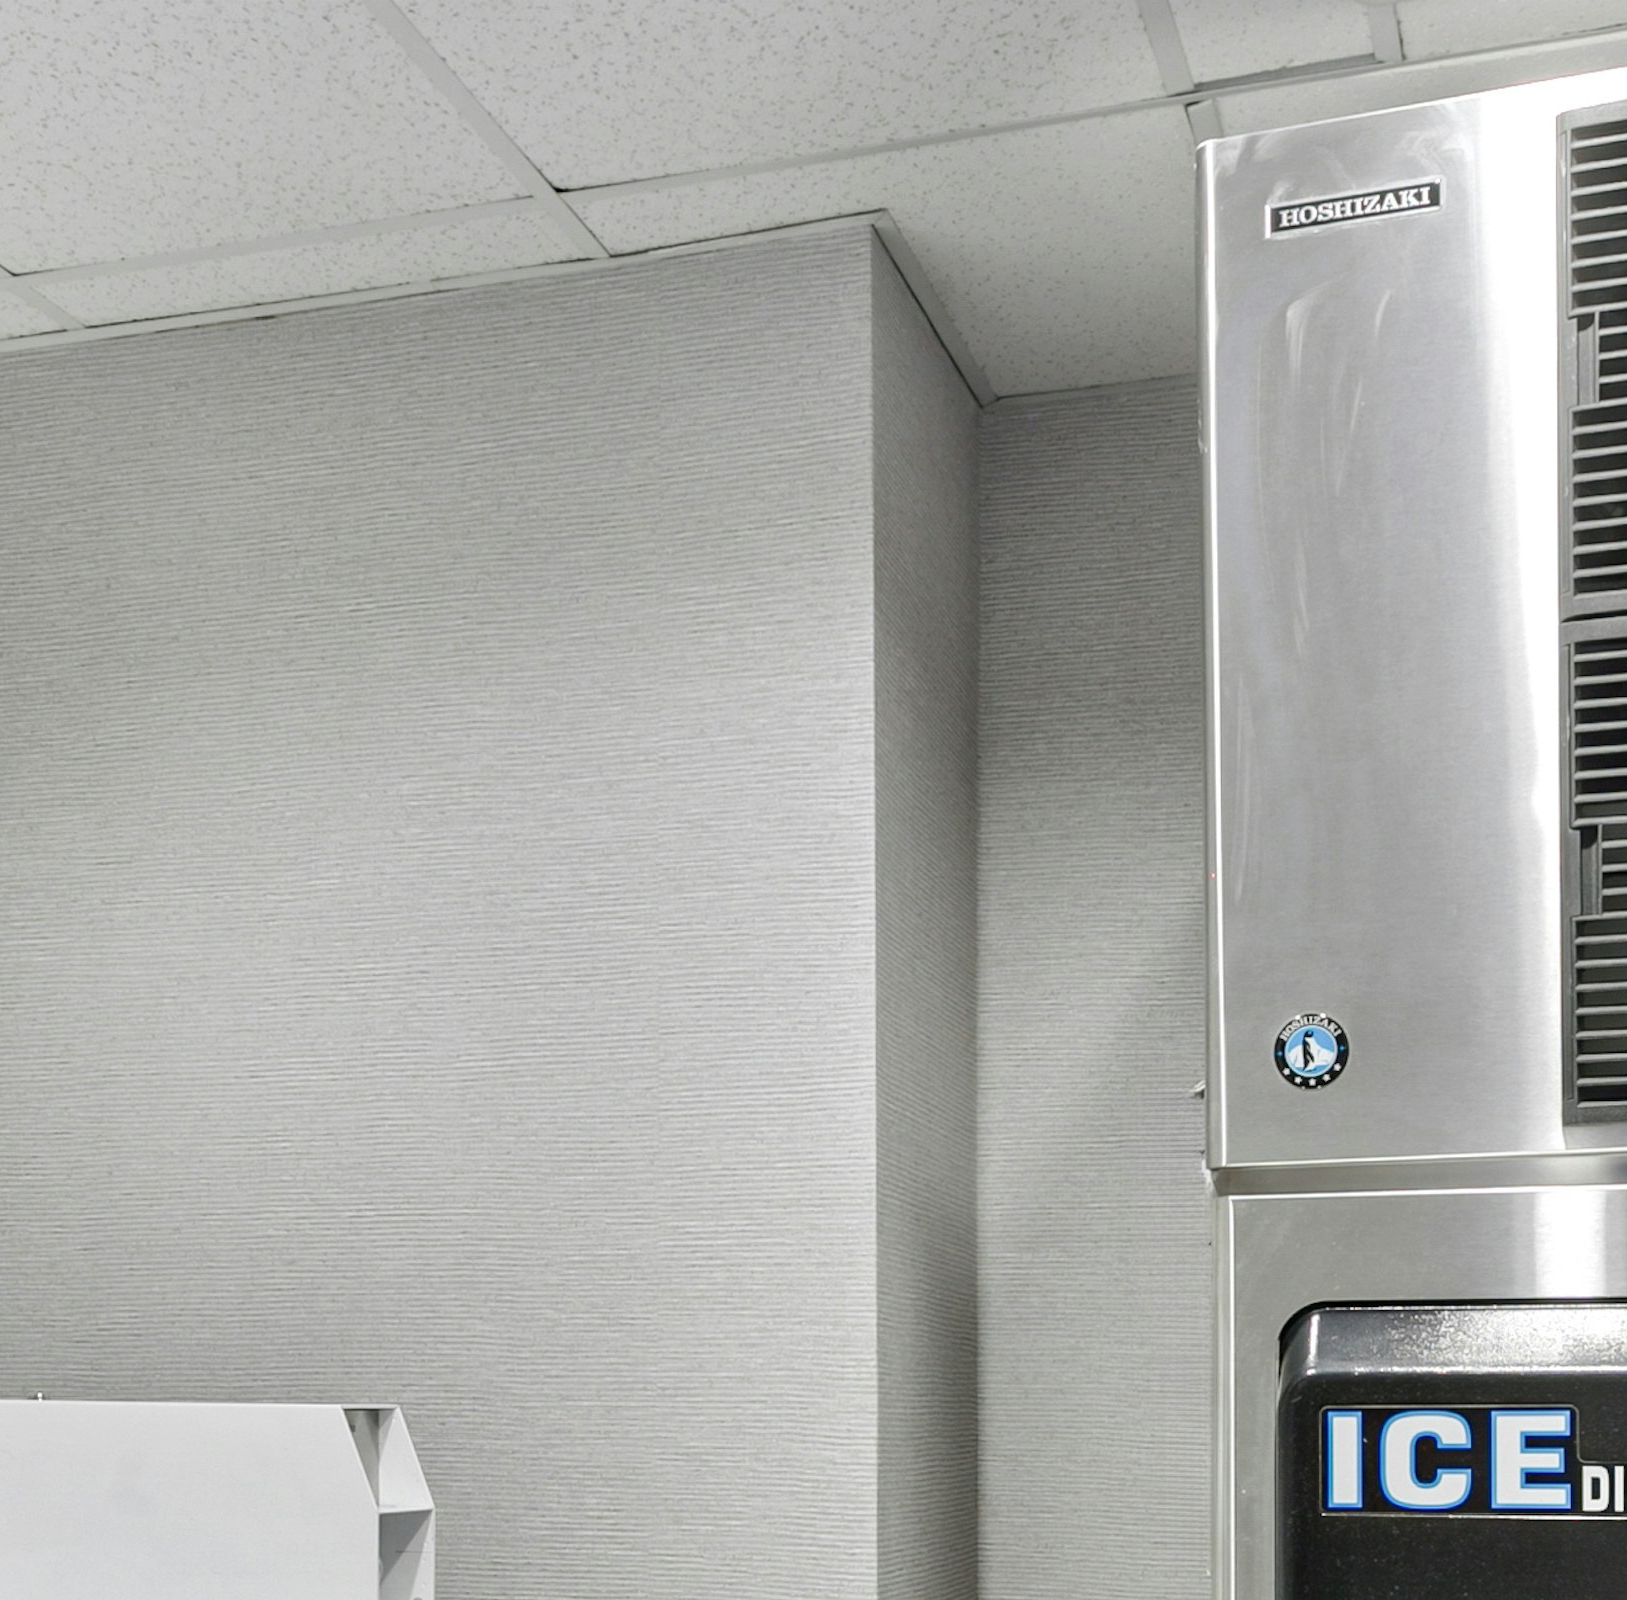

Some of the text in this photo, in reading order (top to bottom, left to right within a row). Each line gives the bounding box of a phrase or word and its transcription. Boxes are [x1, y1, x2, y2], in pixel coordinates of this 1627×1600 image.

[1278, 185, 1431, 228] HOSHIZAKI
[1279, 1015, 1343, 1042] HOSHIZAKI
[1326, 1409, 1572, 1511] ICE
